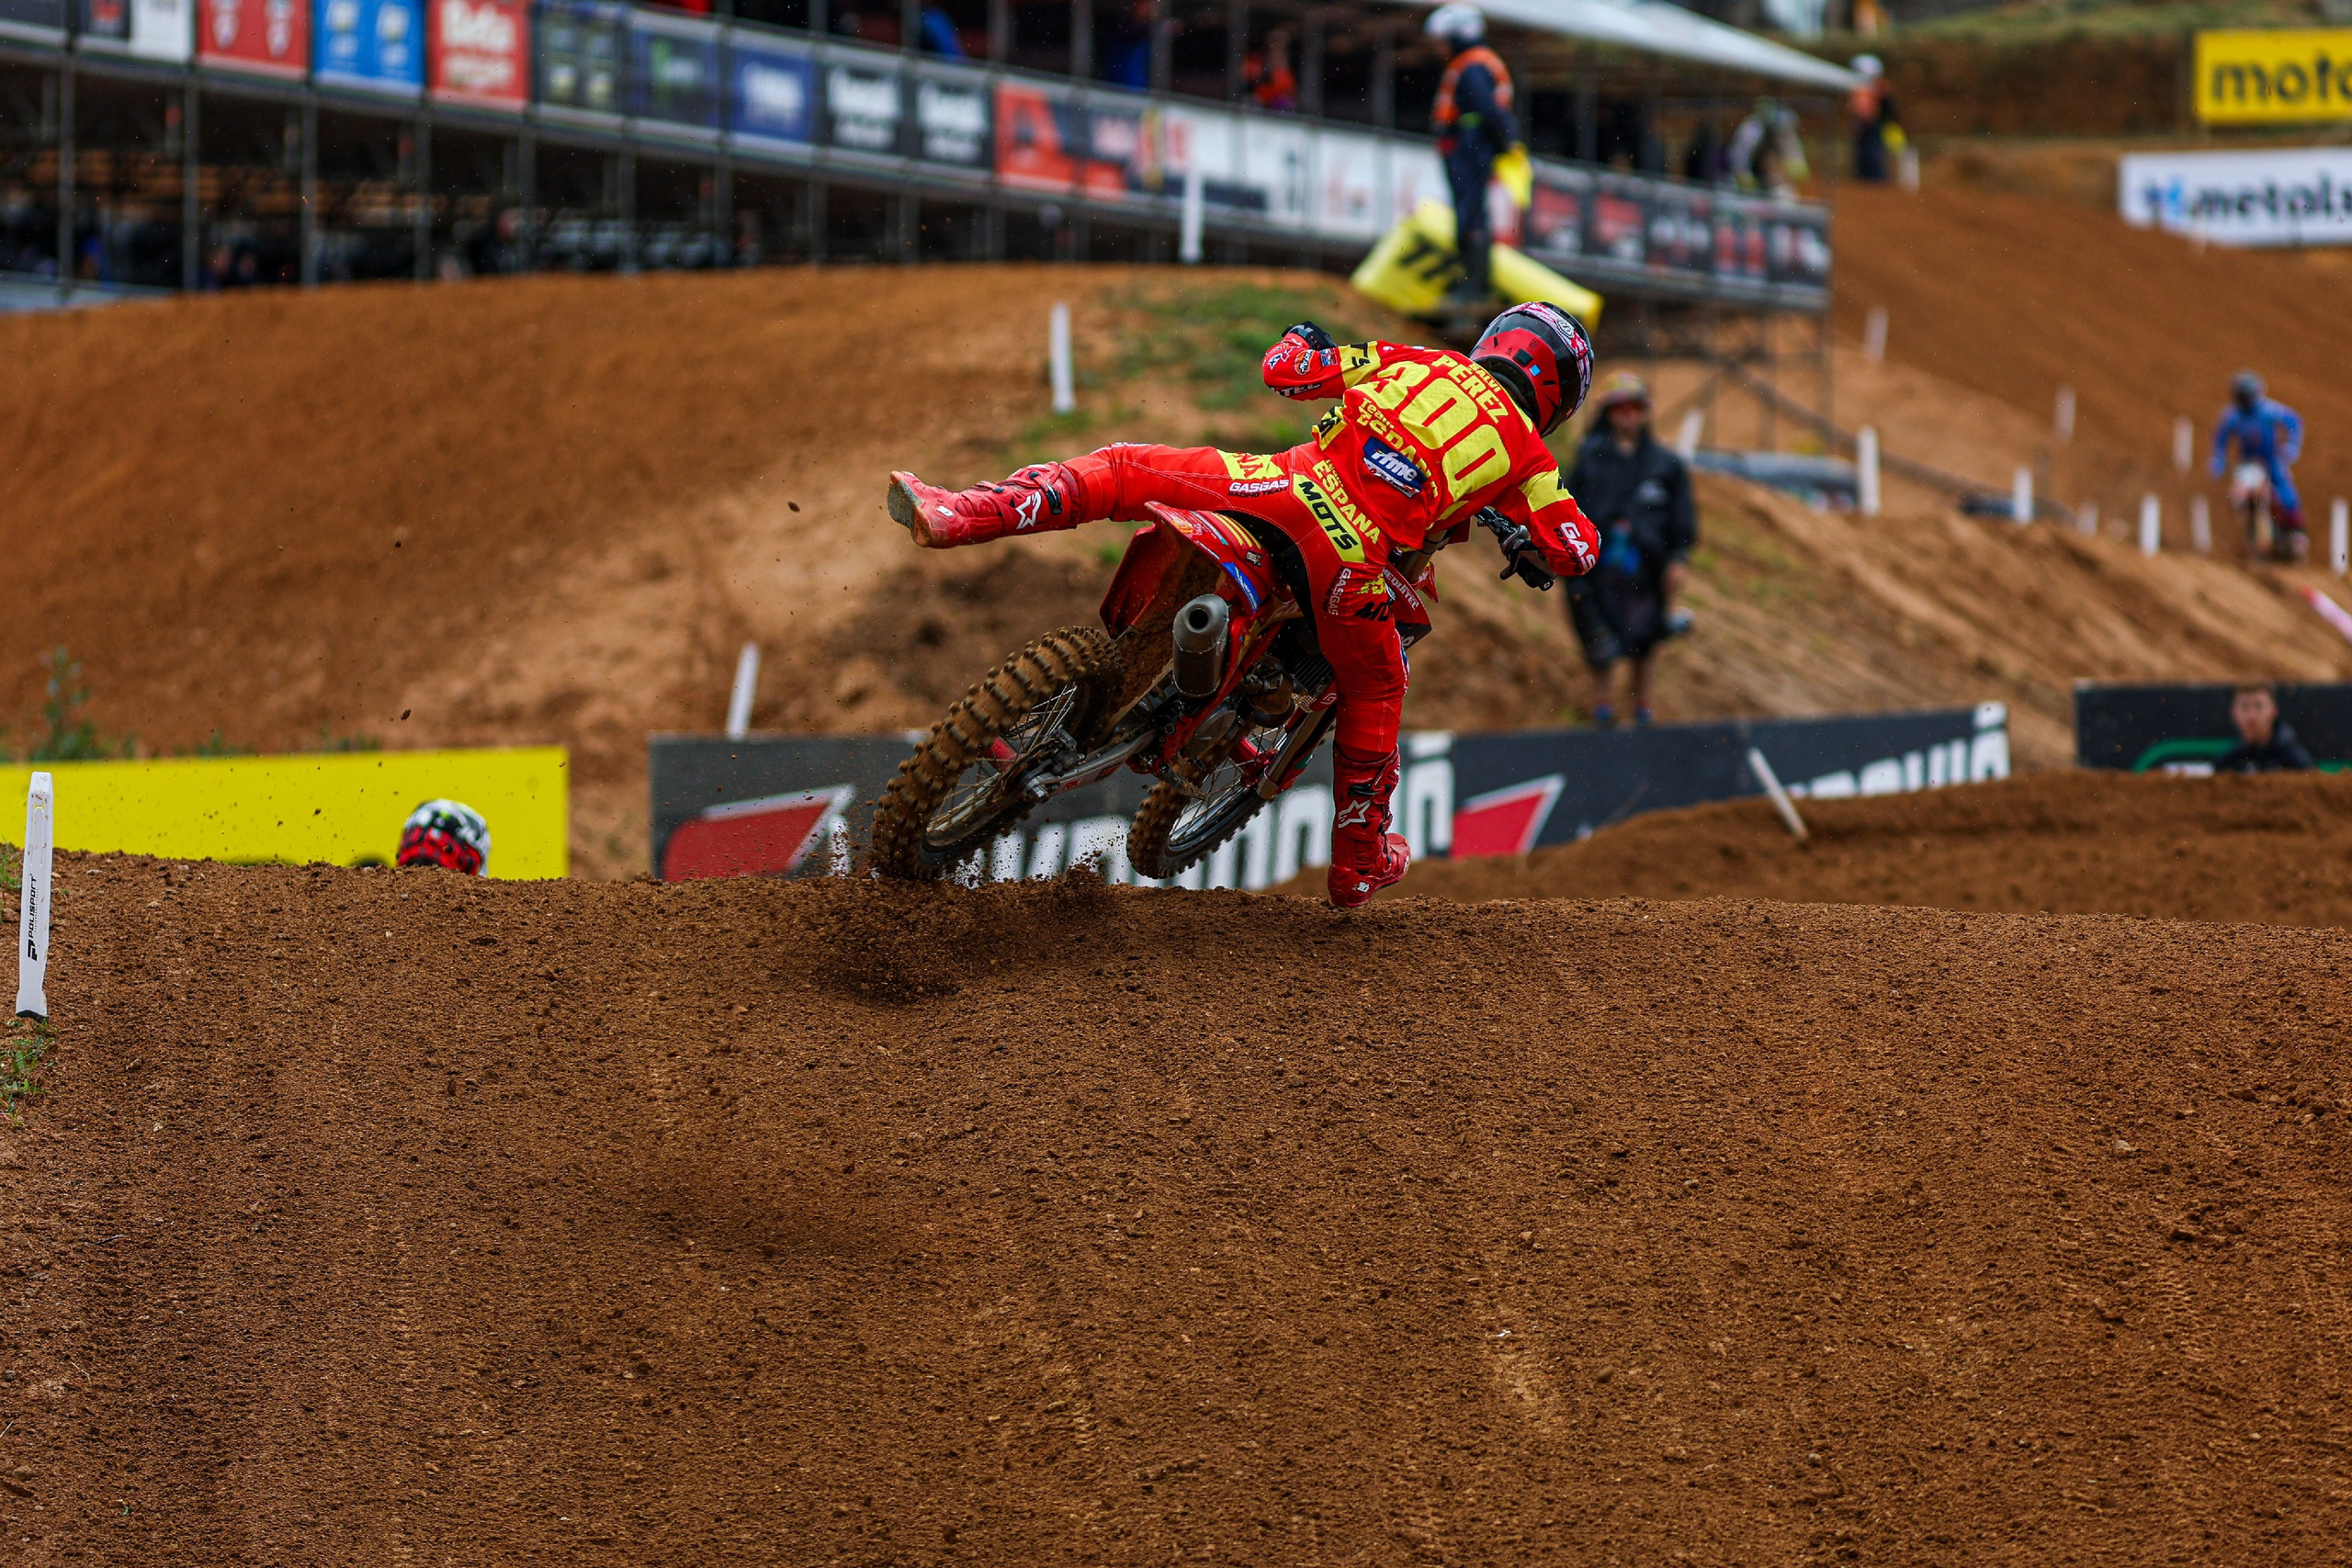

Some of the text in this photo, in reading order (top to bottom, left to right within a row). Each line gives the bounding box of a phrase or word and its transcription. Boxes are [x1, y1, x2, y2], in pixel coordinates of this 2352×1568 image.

[1430, 355, 1509, 424] PEREZ
[1229, 479, 1290, 493] GASGAS
[1298, 481, 1359, 550] MOTS
[1328, 568, 1352, 615] GASGAS
[28, 875, 38, 938] POLISPORT
